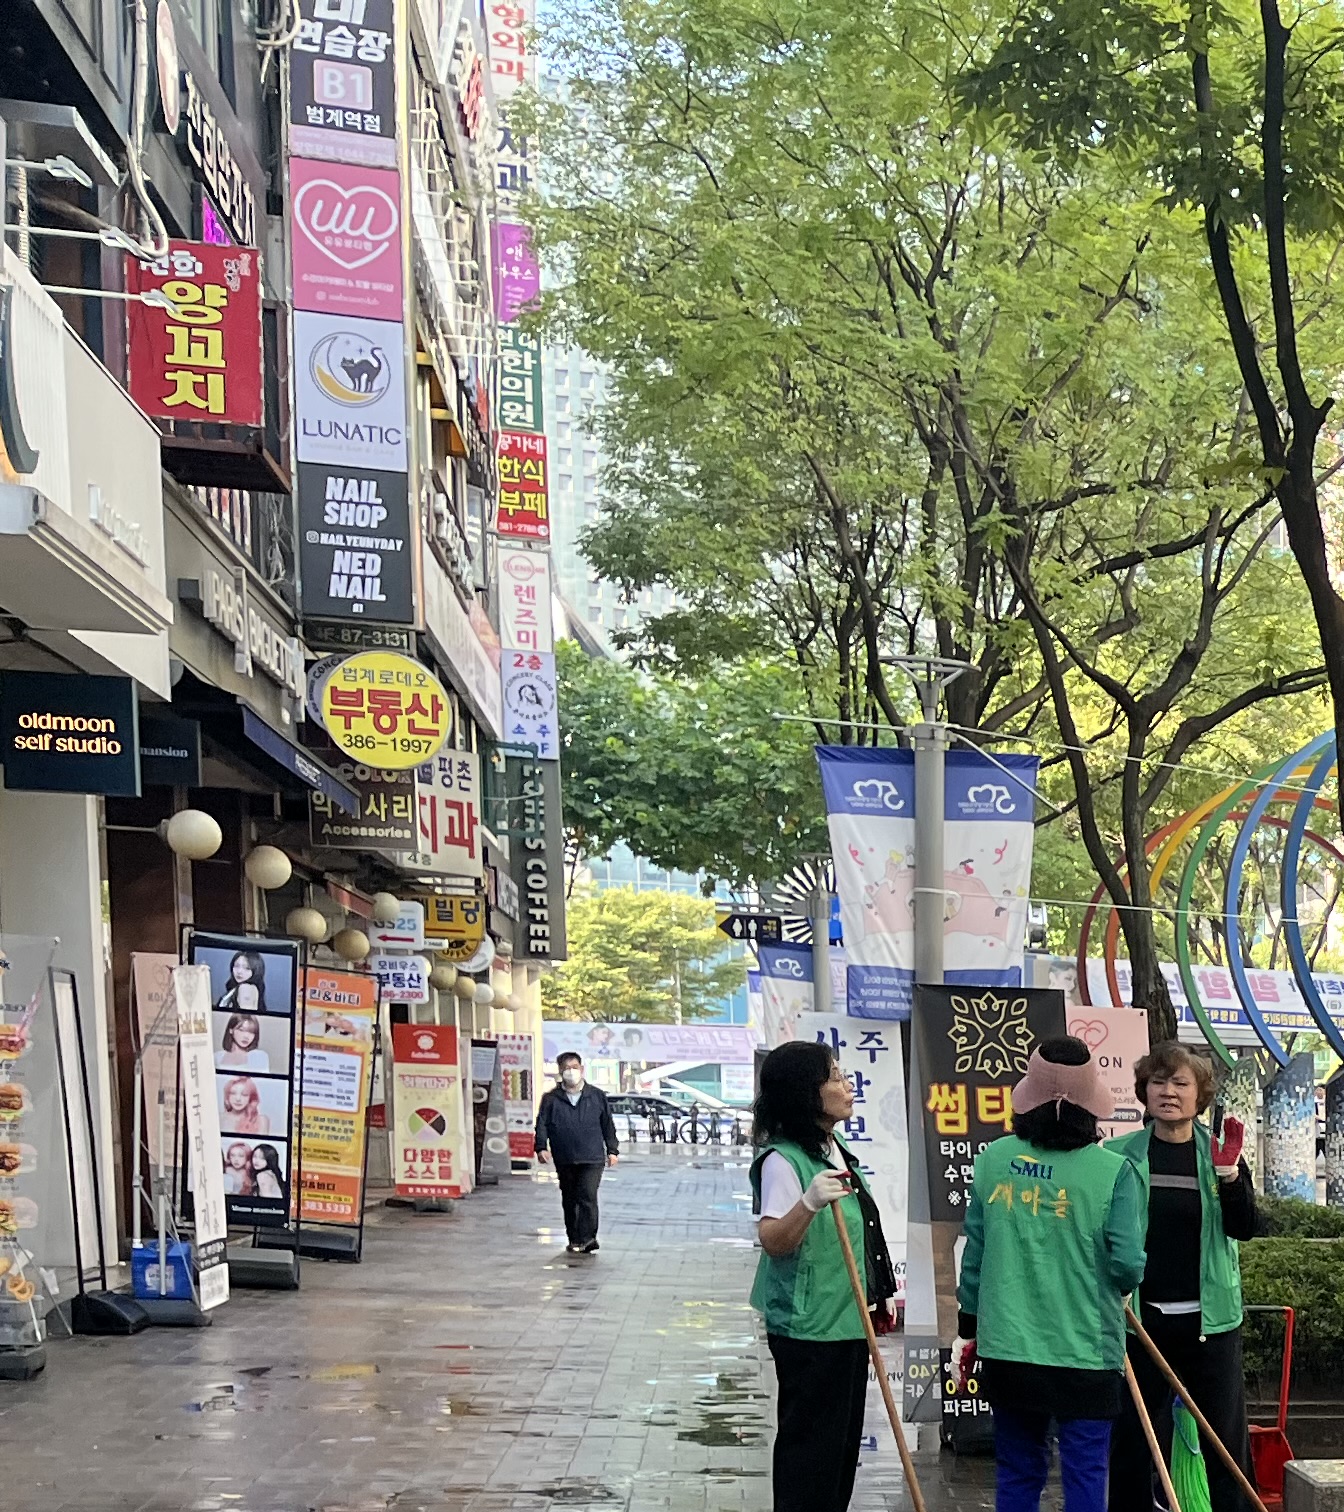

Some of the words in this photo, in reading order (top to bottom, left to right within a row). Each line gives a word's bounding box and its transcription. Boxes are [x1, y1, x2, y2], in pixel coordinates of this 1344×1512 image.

[293, 19, 391, 62] 연습장
[323, 67, 366, 104] B1
[306, 105, 381, 133] 범계역점
[500, 351, 538, 429] 한의원
[302, 417, 402, 446] LUNATIC
[499, 455, 544, 487] 한식
[326, 476, 382, 504] NAIL
[323, 501, 387, 529] SHOP
[499, 490, 546, 520] 부페
[333, 550, 381, 576] NED
[328, 574, 386, 602] NAIL
[513, 584, 538, 649] 렌즈미
[513, 653, 543, 670] 2층
[18, 712, 115, 733] oldmoon
[330, 686, 443, 738] 부동산
[14, 733, 53, 751] self
[55, 735, 122, 755] studio
[343, 734, 433, 755] 386-1997
[438, 756, 473, 793] 평촌
[321, 822, 412, 839] Accessories
[527, 858, 551, 953] COFFEE
[378, 960, 418, 971] 모비우스
[377, 972, 422, 989] 부동산
[403, 1148, 452, 1163] 다양한
[1010, 1157, 1054, 1180] SMU
[987, 1183, 1072, 1218] 새마을
